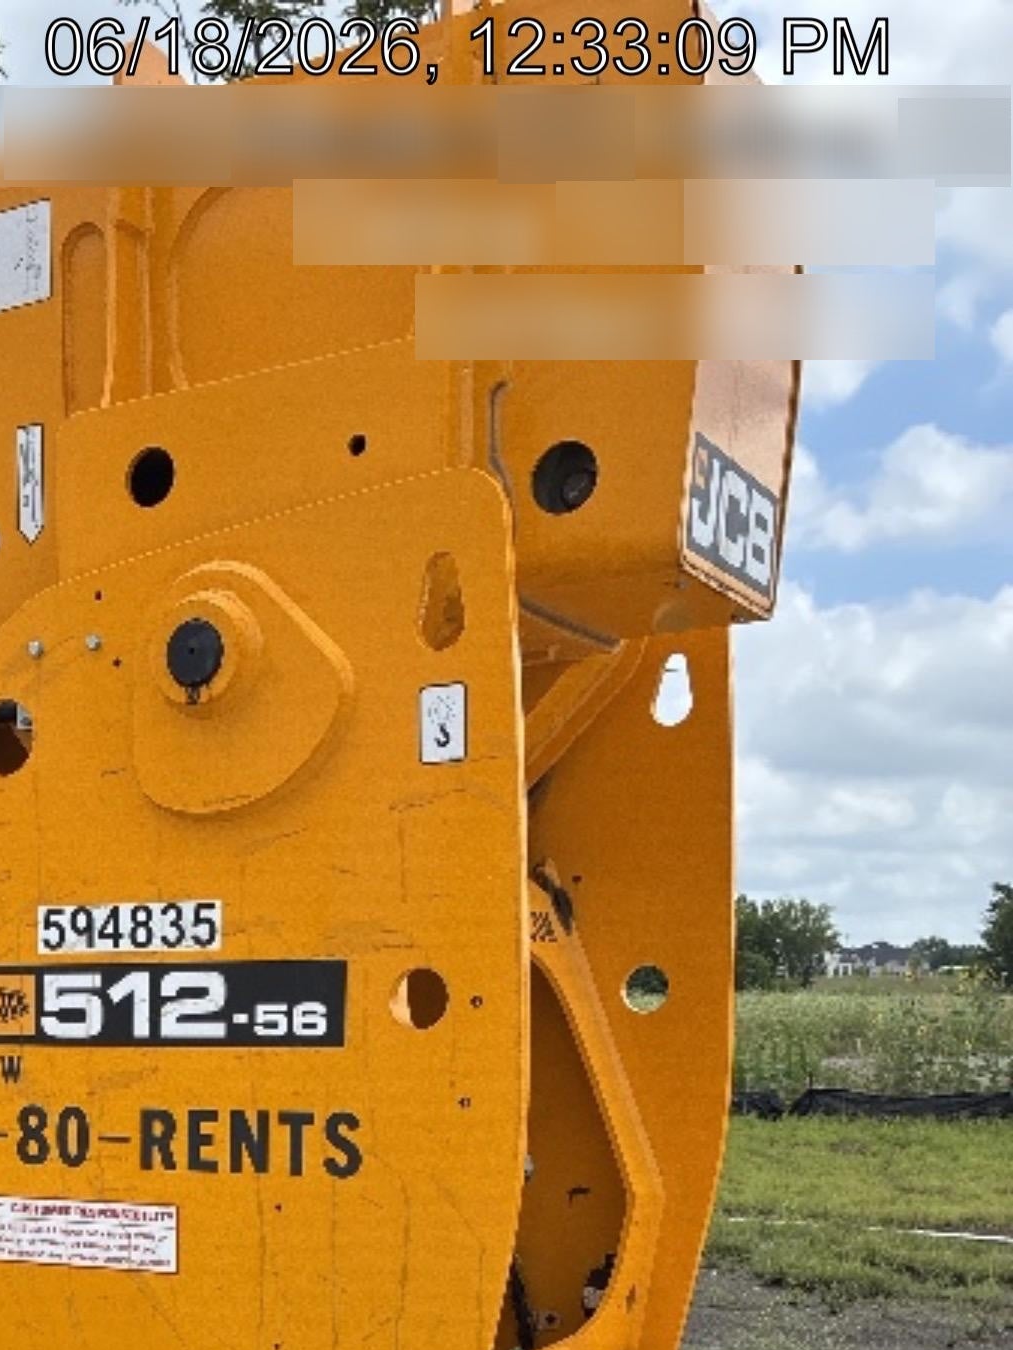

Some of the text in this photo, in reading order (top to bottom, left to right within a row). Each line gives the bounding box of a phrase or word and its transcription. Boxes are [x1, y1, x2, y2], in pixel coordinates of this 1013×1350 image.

[691, 458, 775, 586] JCB
[41, 903, 217, 950] 594835
[40, 970, 328, 1040] 512-56
